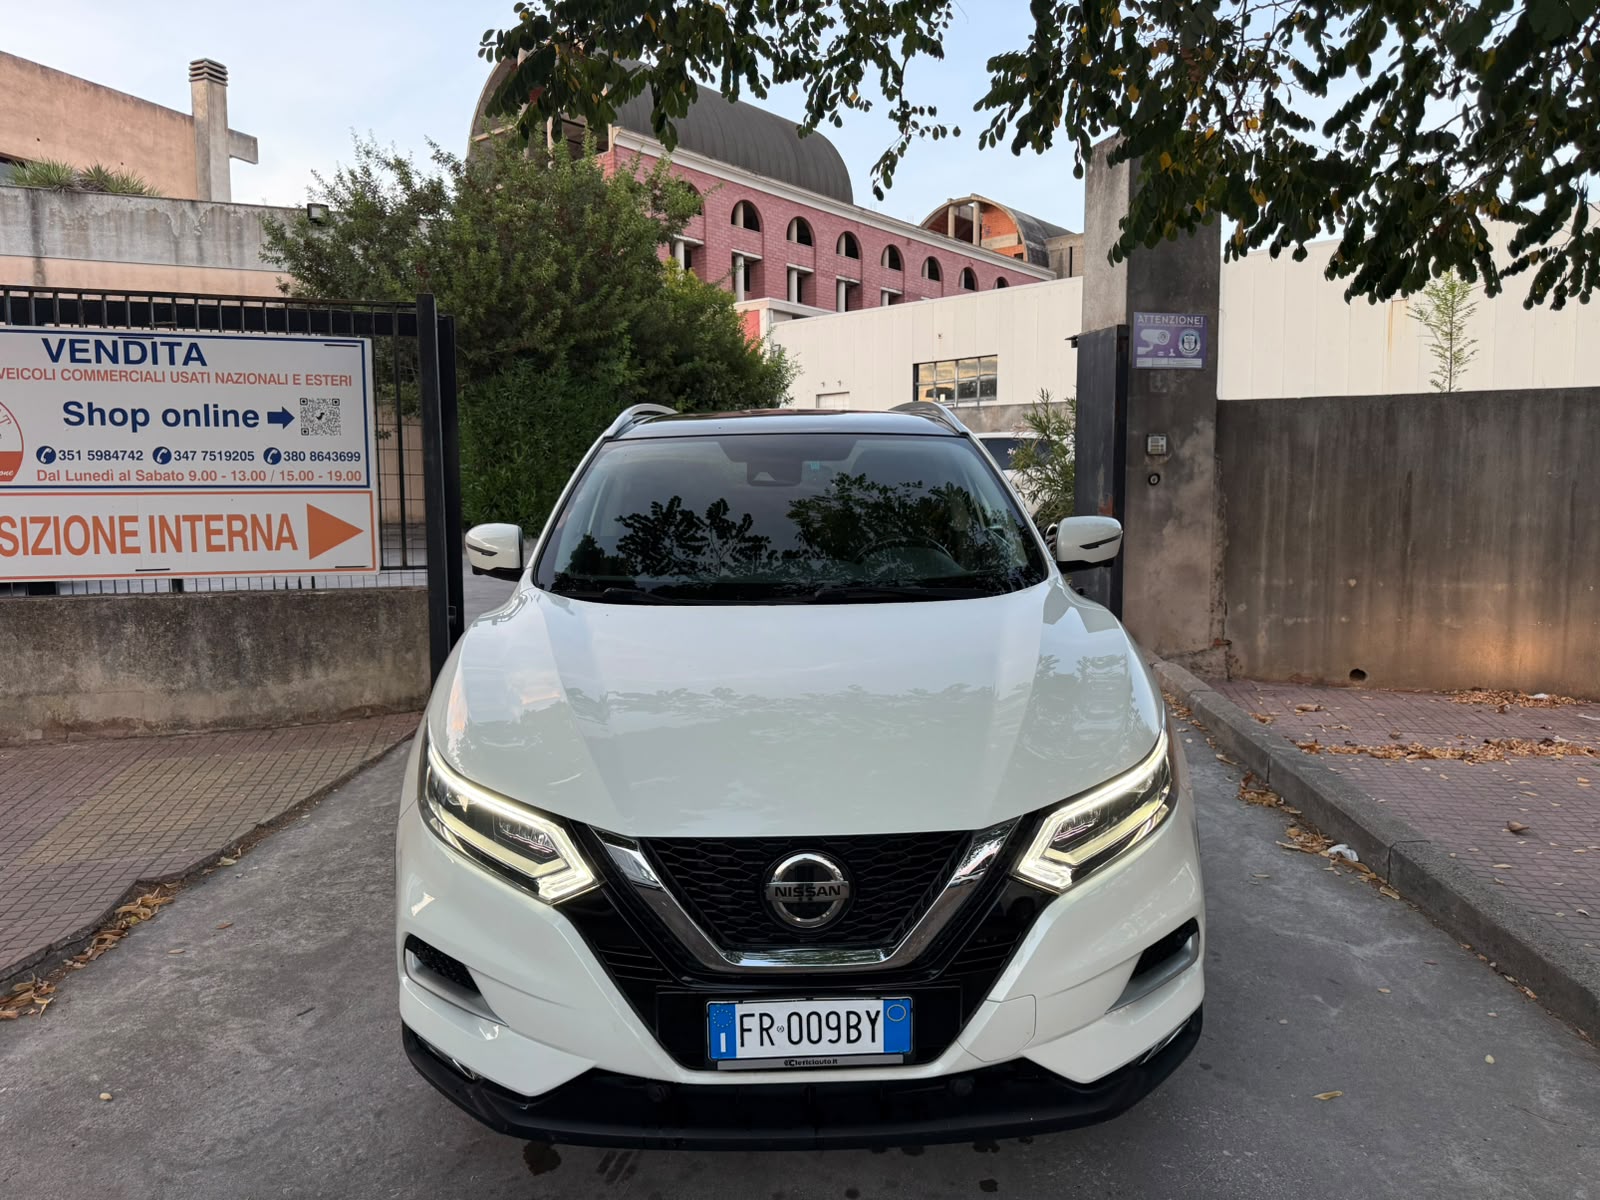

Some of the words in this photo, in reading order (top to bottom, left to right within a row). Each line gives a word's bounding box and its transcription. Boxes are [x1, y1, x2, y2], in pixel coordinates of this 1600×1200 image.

[1137, 315, 1204, 325] ATTENZIONE!
[41, 337, 208, 366] VENDITA
[61, 368, 166, 383] COMMERCIALI
[170, 371, 210, 384] USATI
[215, 372, 289, 385] NAZIONALI
[292, 374, 302, 386] E
[305, 374, 352, 387] ESTERI
[62, 400, 151, 433] Shop
[161, 403, 260, 428] online
[58, 450, 82, 461] 351
[87, 450, 144, 461] 5984742
[174, 450, 197, 461] 347
[201, 450, 255, 462] 7519205
[283, 451, 306, 462] 380
[309, 451, 361, 462] 8643699
[37, 469, 60, 482] Dal
[65, 469, 114, 482] Lunedì
[118, 469, 131, 482] al
[136, 469, 185, 482] Sabato
[188, 470, 218, 482] 9.00
[231, 470, 267, 482] 13.00
[280, 470, 315, 482] 15.00
[327, 470, 362, 482] 19.00
[0, 514, 141, 558] SIZIONE
[148, 512, 299, 554] INTERNA
[773, 885, 842, 898] NISSAN
